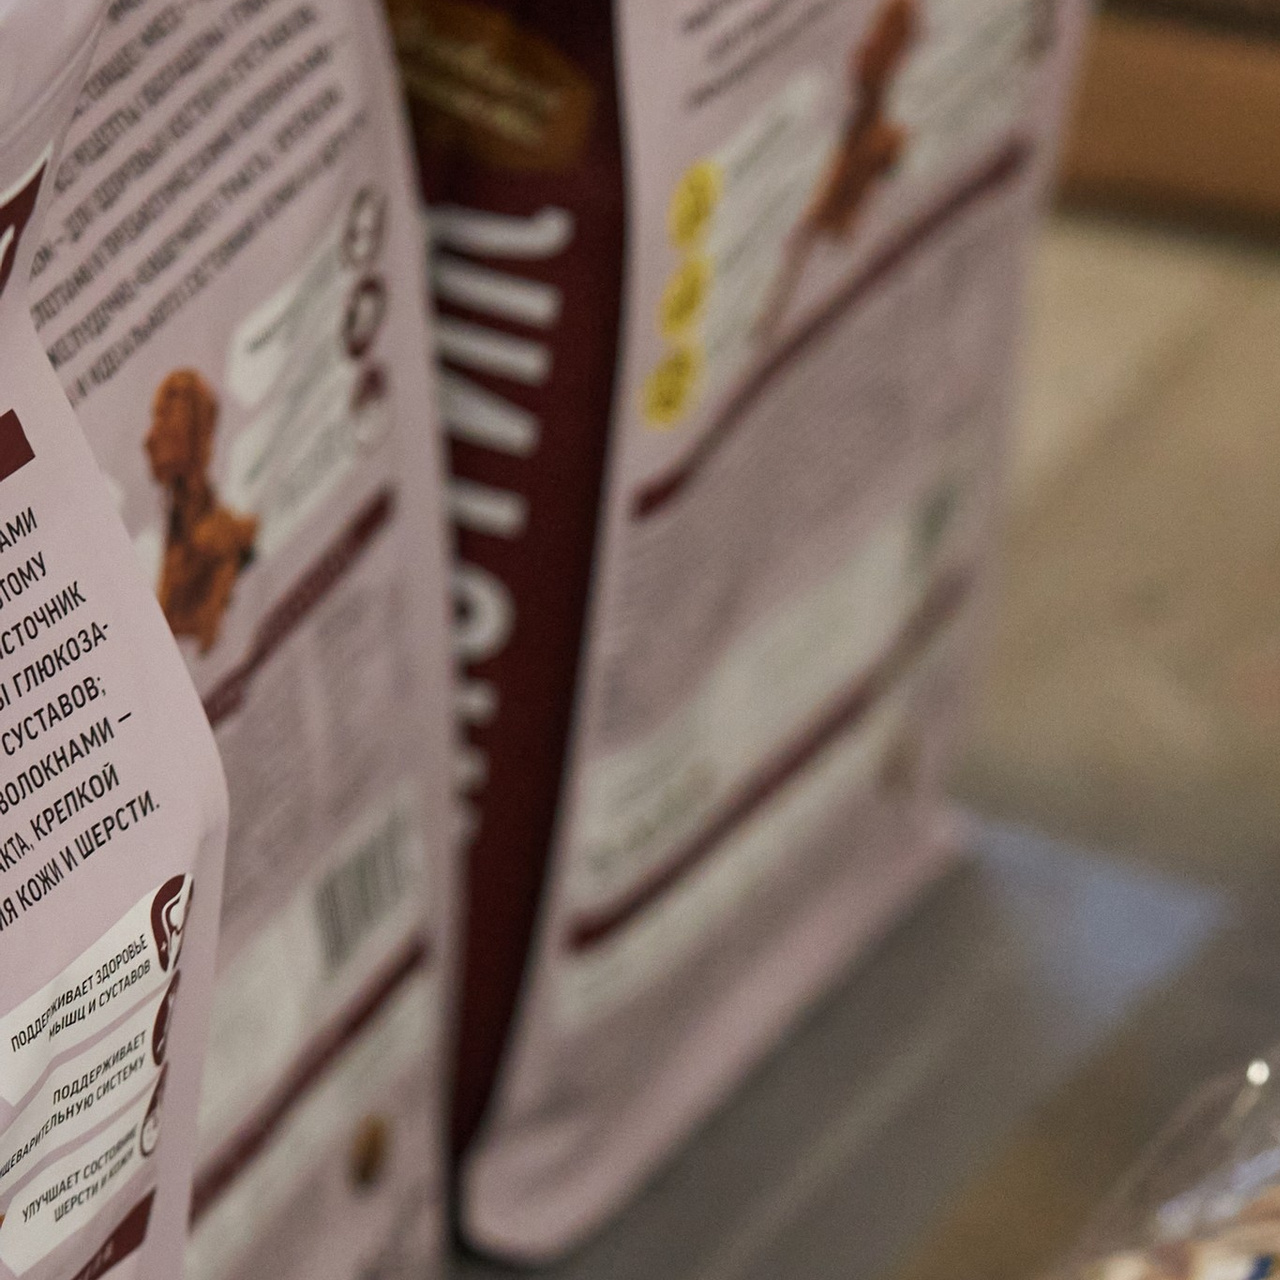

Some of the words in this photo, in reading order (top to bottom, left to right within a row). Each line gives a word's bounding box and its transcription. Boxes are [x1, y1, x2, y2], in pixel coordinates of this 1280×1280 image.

[12, 621, 108, 697] ГЛЮКОЗА-
[2, 676, 106, 756] СУСТАВОВ;
[29, 762, 120, 841] КРЕПКОЙ
[16, 858, 64, 911] КОЖИ
[59, 846, 78, 871] И
[74, 790, 160, 860] ШЕРСТИ.
[10, 975, 94, 1053] ПОДДЕРЖИВАЕТ
[95, 934, 149, 985] ЗДОРОВЬЕ
[48, 1006, 86, 1042] МЫШЦ
[88, 997, 96, 1015] И
[99, 959, 151, 1007] СУСТАВОВ
[53, 1029, 147, 1105] ПОДДЕРЖИВАЕТ
[96, 1054, 146, 1101] СИСТЕМУ
[22, 1169, 81, 1223] УЛУЧШАЕТ
[54, 1182, 99, 1223] ШЕРСТИ
